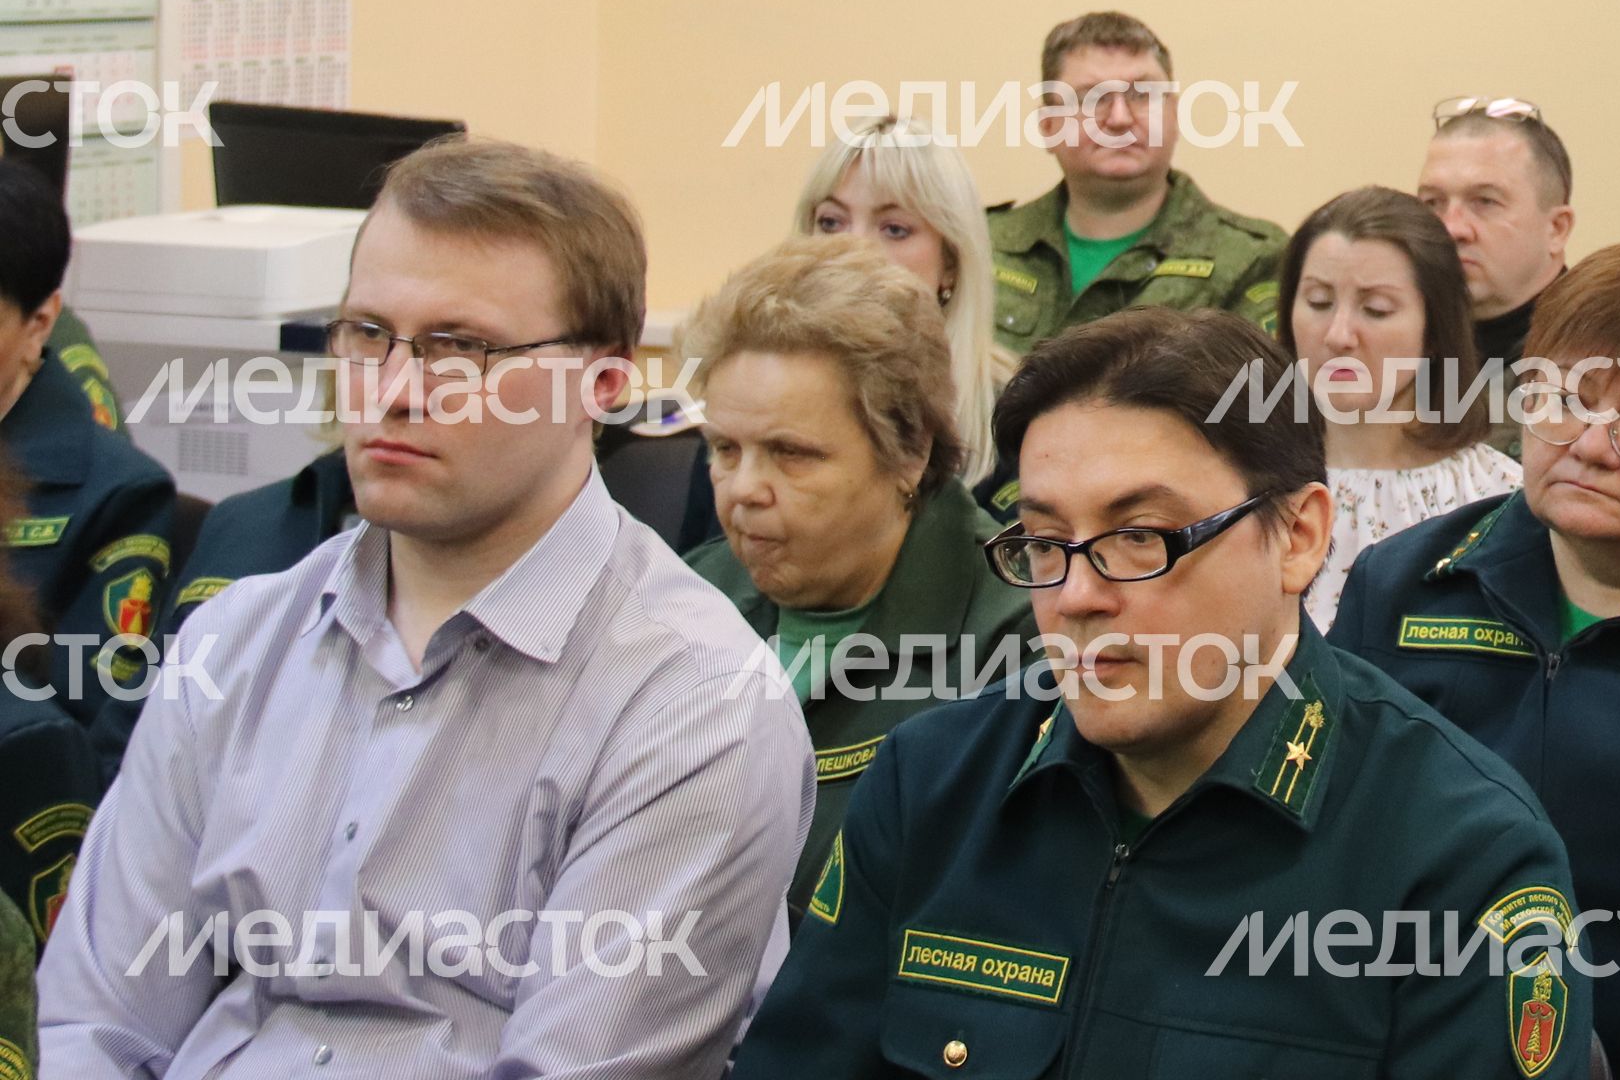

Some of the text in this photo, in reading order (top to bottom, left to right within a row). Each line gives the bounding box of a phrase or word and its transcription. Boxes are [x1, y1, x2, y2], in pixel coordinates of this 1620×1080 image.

[1406, 625, 1525, 647] лесная охра
[906, 945, 1056, 988] лесная охрана
